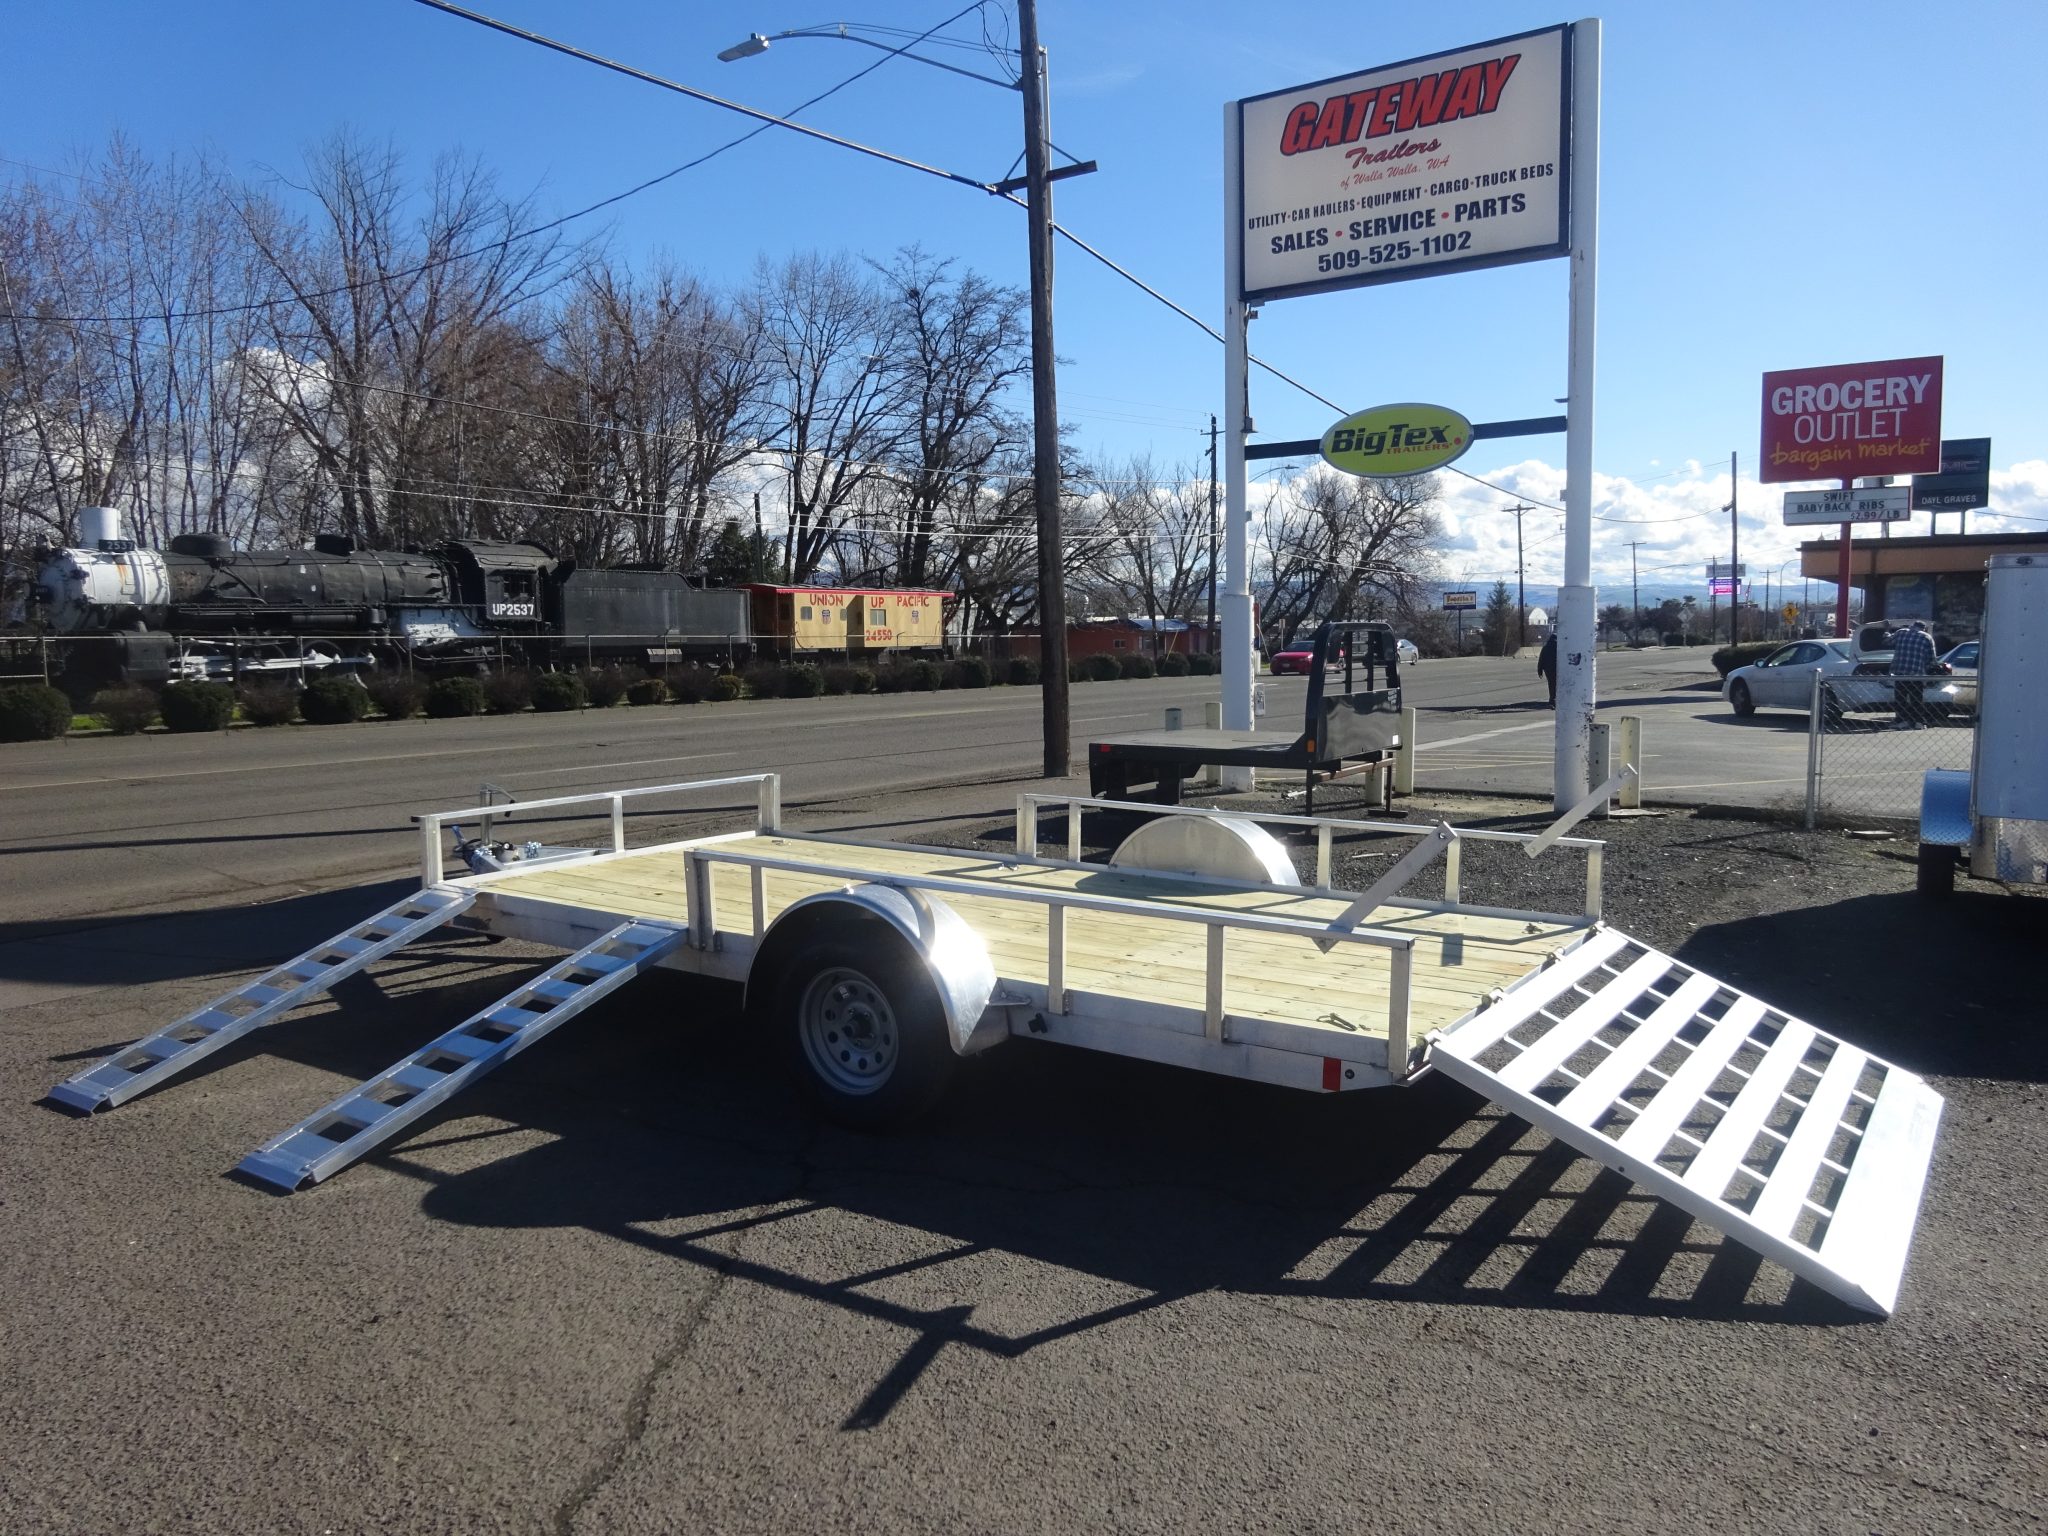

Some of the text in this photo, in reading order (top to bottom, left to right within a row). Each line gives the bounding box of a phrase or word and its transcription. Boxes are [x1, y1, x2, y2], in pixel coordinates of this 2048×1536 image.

[1279, 53, 1522, 157] GATEWAY
[1345, 138, 1442, 169] Trailers
[1340, 176, 1350, 191] of
[1353, 170, 1383, 185] Walla
[1426, 155, 1450, 170] WA
[1248, 163, 1554, 230] UTILITY CAR HAULERS EQUIPMENT CARGO TRUCK BEDS
[1271, 193, 1526, 255] SALES SERVICE PARTS
[1318, 231, 1472, 273] 509-525-1102
[1771, 374, 1932, 416] GROCERY
[1794, 407, 1908, 444] OUTLET
[1385, 443, 1450, 455] TRAILERS
[1771, 438, 1931, 471] bargain market
[1797, 500, 1885, 513] BABYBACK RIBS
[1823, 491, 1855, 502] SWIFT
[1944, 495, 1977, 504] GRAVES
[492, 604, 534, 616] UP2537
[809, 594, 930, 608] UNION UP PACIFIC
[865, 629, 893, 642] 24550
